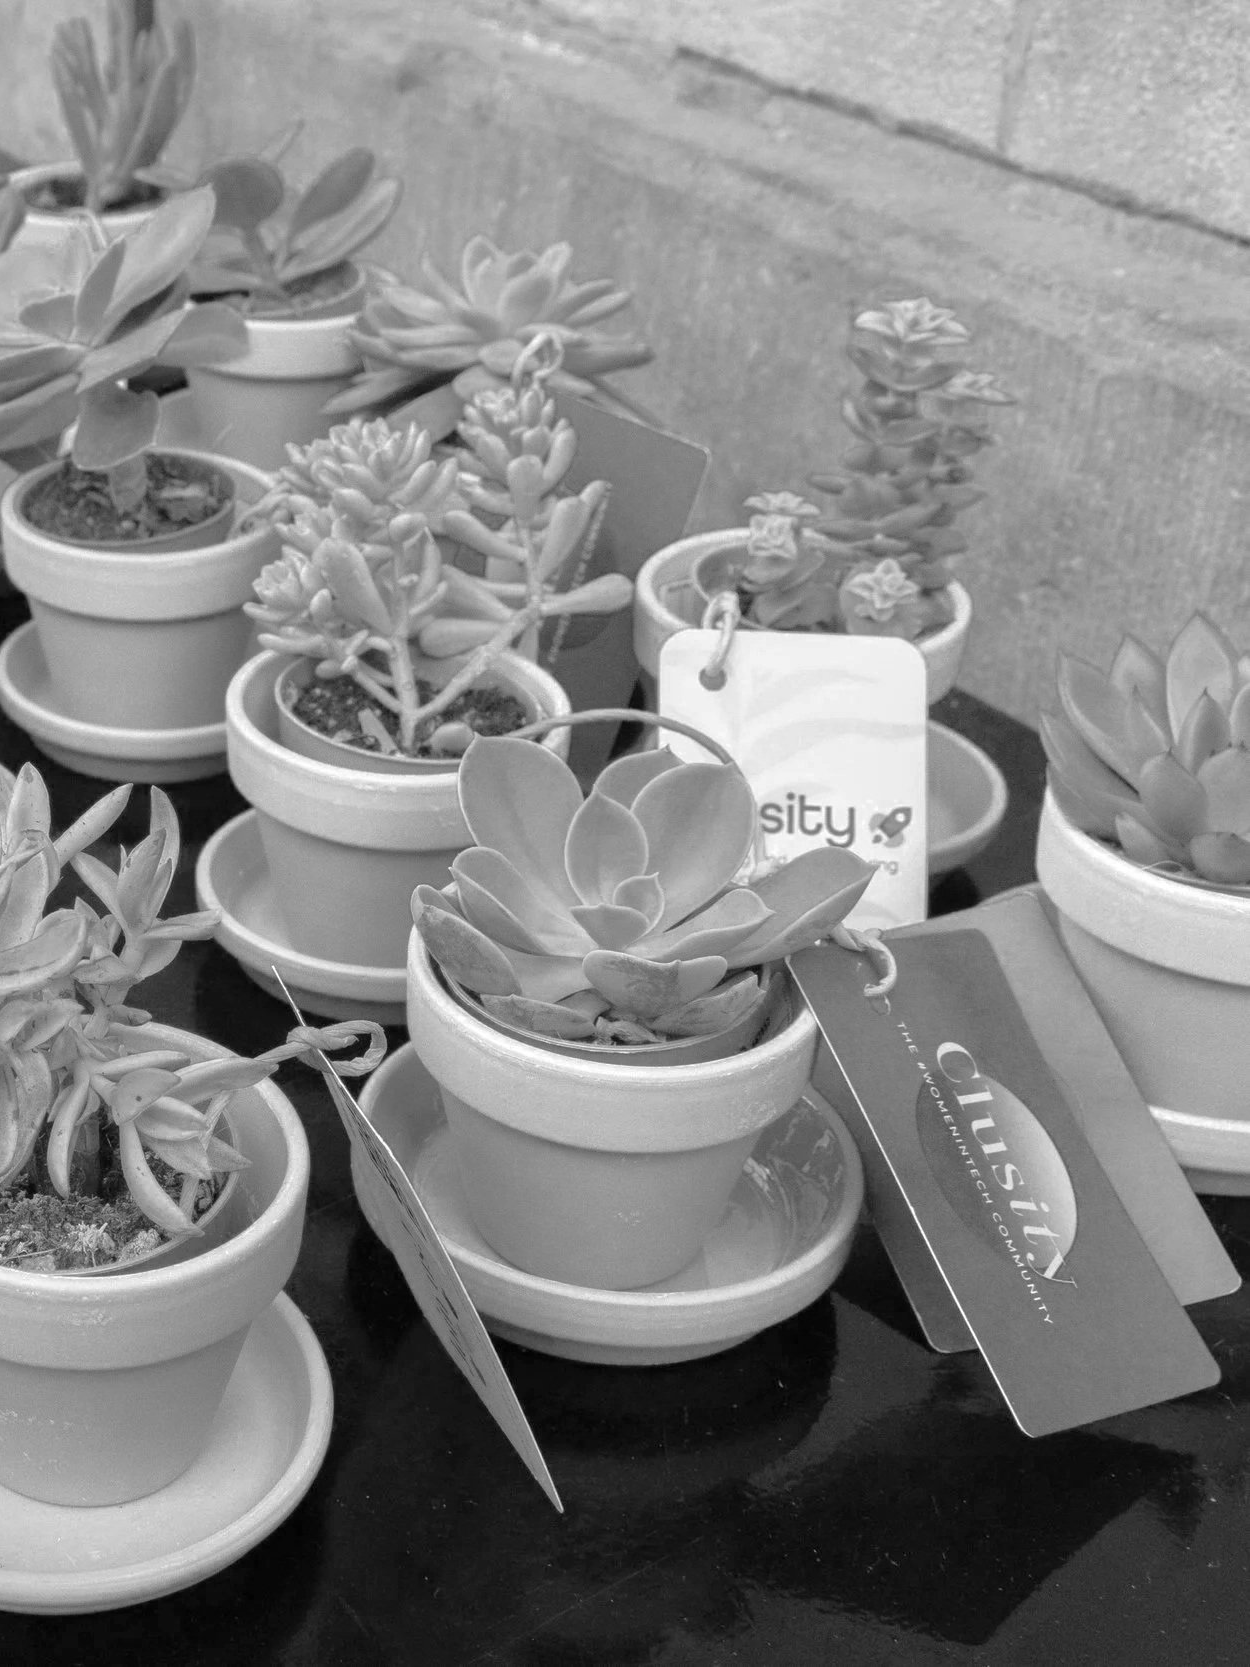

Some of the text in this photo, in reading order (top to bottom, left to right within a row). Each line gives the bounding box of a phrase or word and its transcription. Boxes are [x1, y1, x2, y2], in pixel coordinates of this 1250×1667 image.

[897, 1022, 1053, 1325] THE #WOMENINTECH COMMUNITY
[937, 1042, 1078, 1289] Clusity
